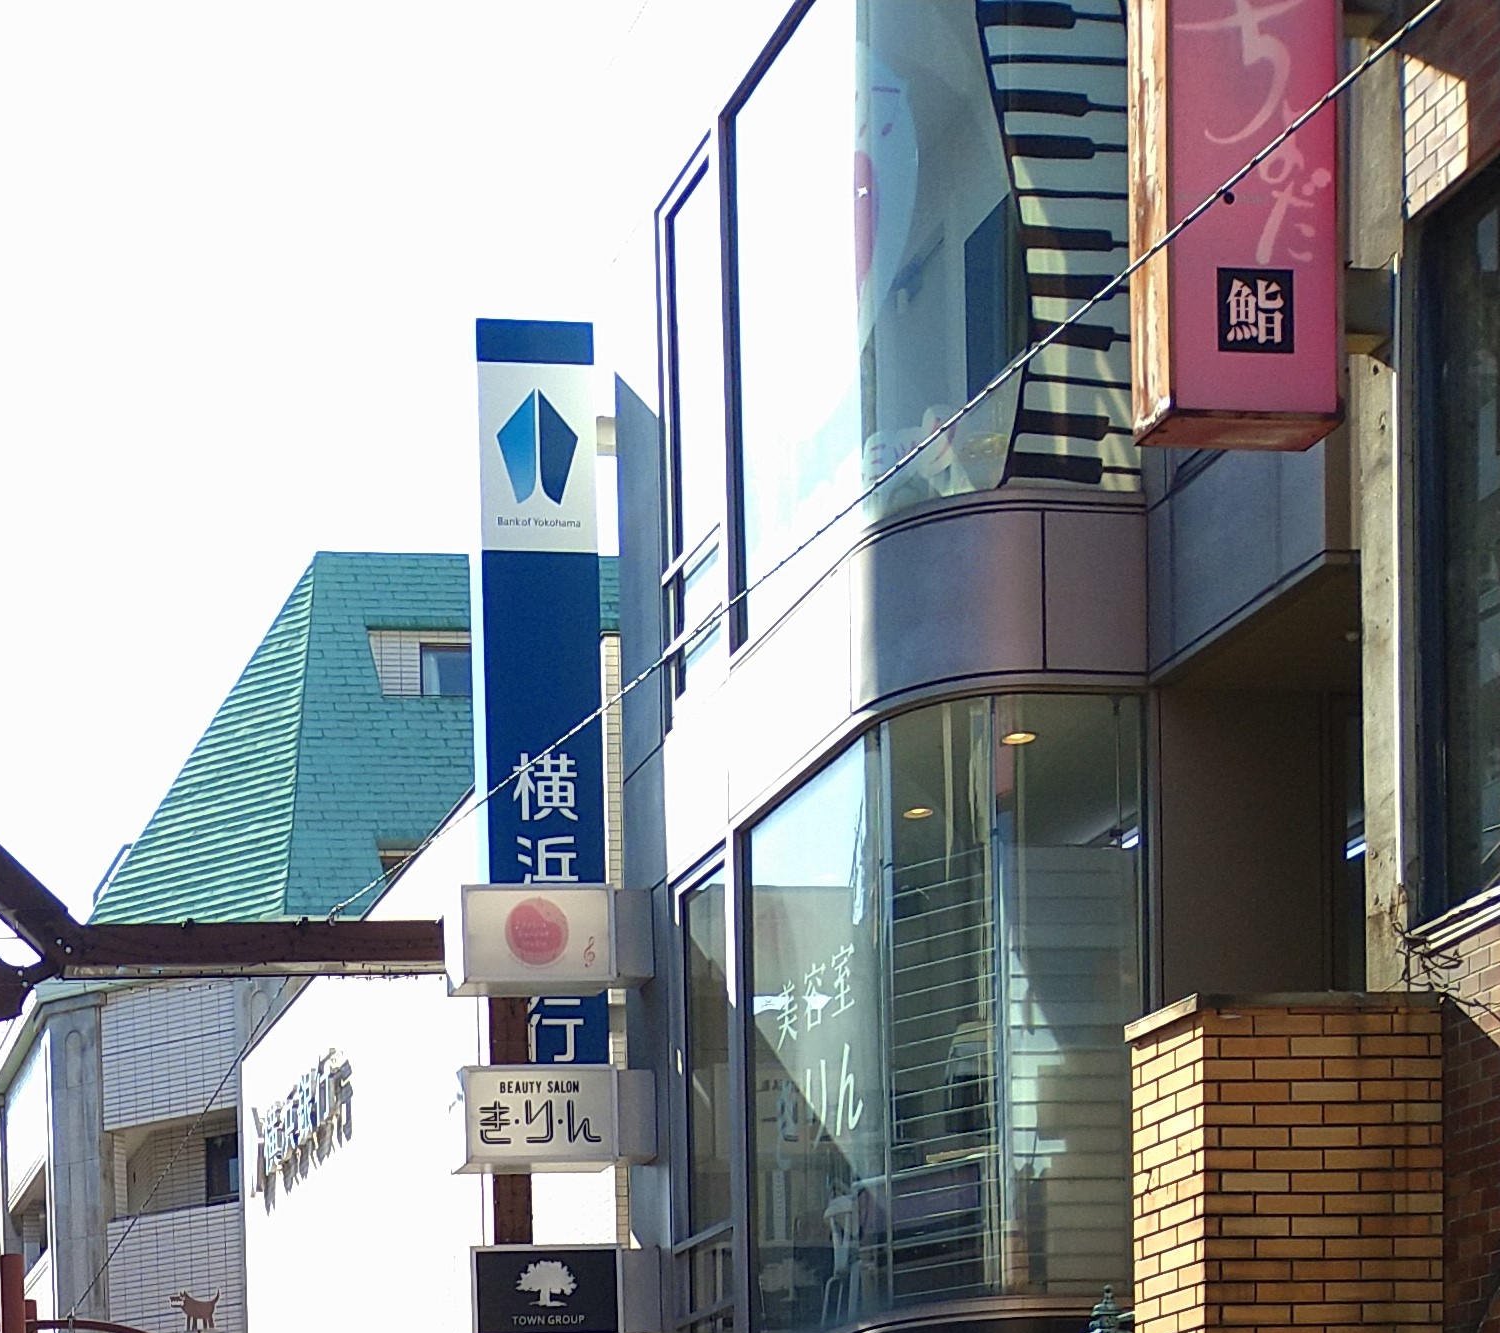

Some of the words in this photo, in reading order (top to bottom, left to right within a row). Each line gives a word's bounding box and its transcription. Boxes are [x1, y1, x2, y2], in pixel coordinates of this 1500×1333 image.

[1225, 278, 1285, 346] 鮨
[497, 516, 521, 528] Bank
[521, 517, 532, 528] of
[533, 517, 581, 529] Yokohama
[512, 752, 585, 1063] 横浜行
[776, 943, 856, 1052] 美容室
[500, 1080, 542, 1095] BEAUTY
[547, 1080, 580, 1094] SALON
[512, 1315, 546, 1326] TOWN
[547, 1314, 585, 1325] GROUP
